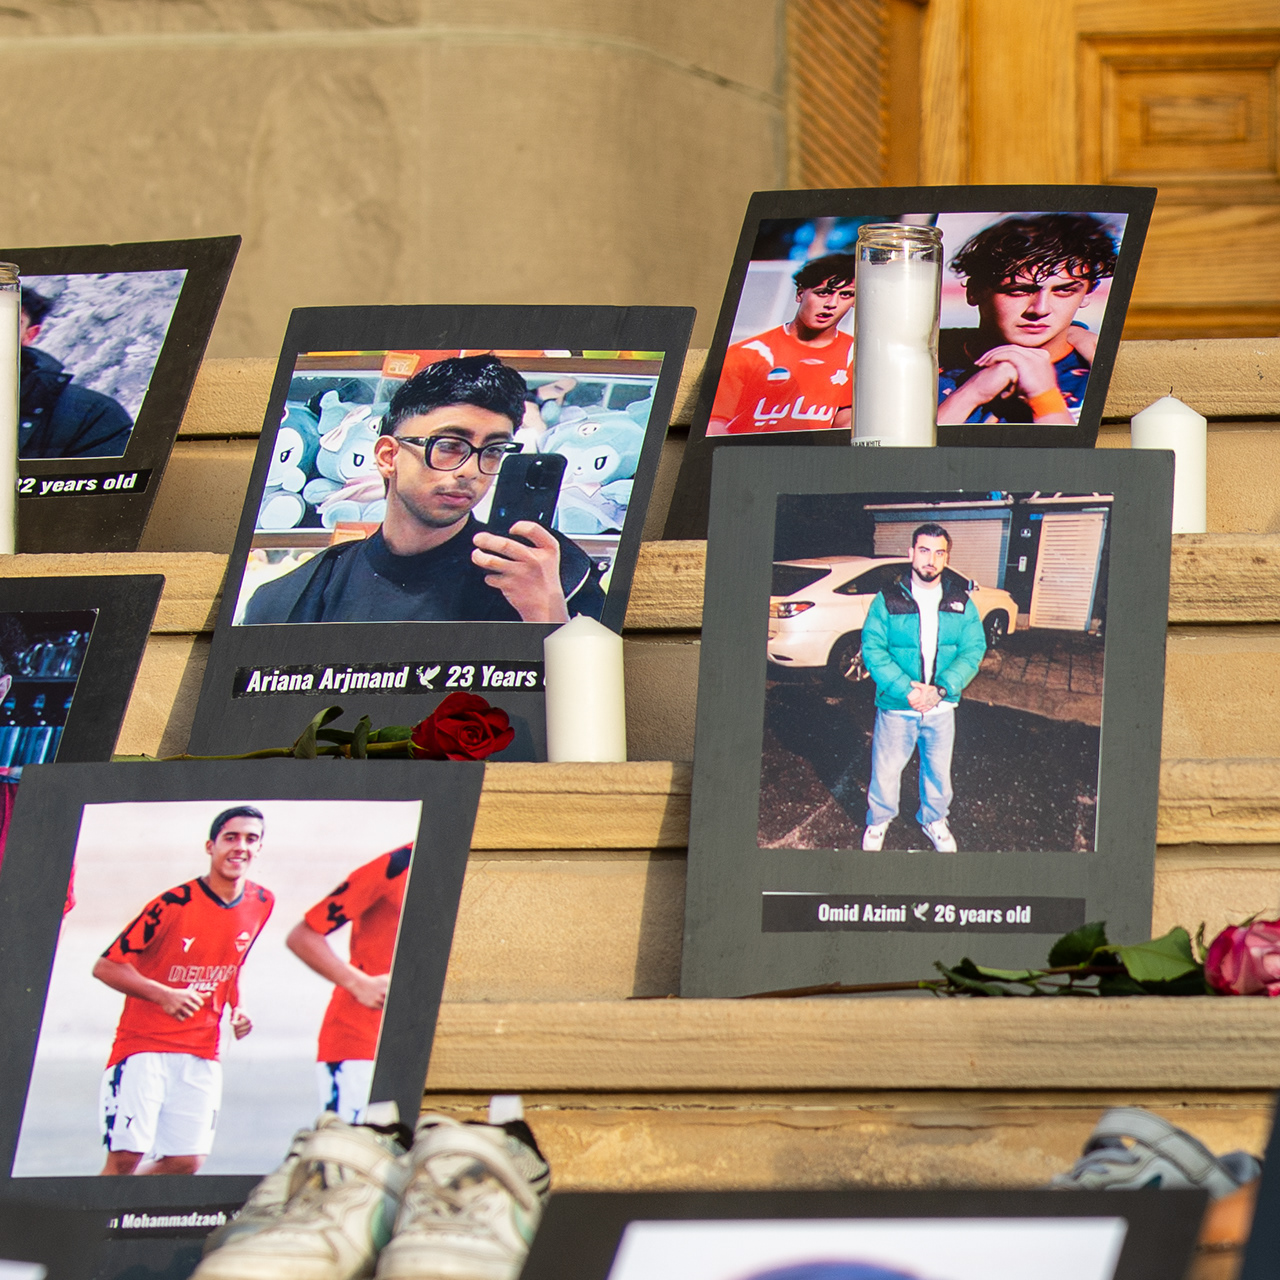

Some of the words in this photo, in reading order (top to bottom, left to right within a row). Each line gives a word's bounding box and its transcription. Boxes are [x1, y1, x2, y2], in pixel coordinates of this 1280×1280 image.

[39, 479, 97, 495] years
[103, 473, 138, 490] old
[246, 670, 313, 692] Ariana
[318, 666, 410, 693] Arjmand
[446, 665, 474, 687] 23
[482, 665, 537, 687] Years
[818, 903, 859, 922] Omid
[863, 904, 906, 922] Azimi
[934, 905, 956, 923] 26
[959, 908, 1002, 926] years
[1006, 905, 1031, 923] old
